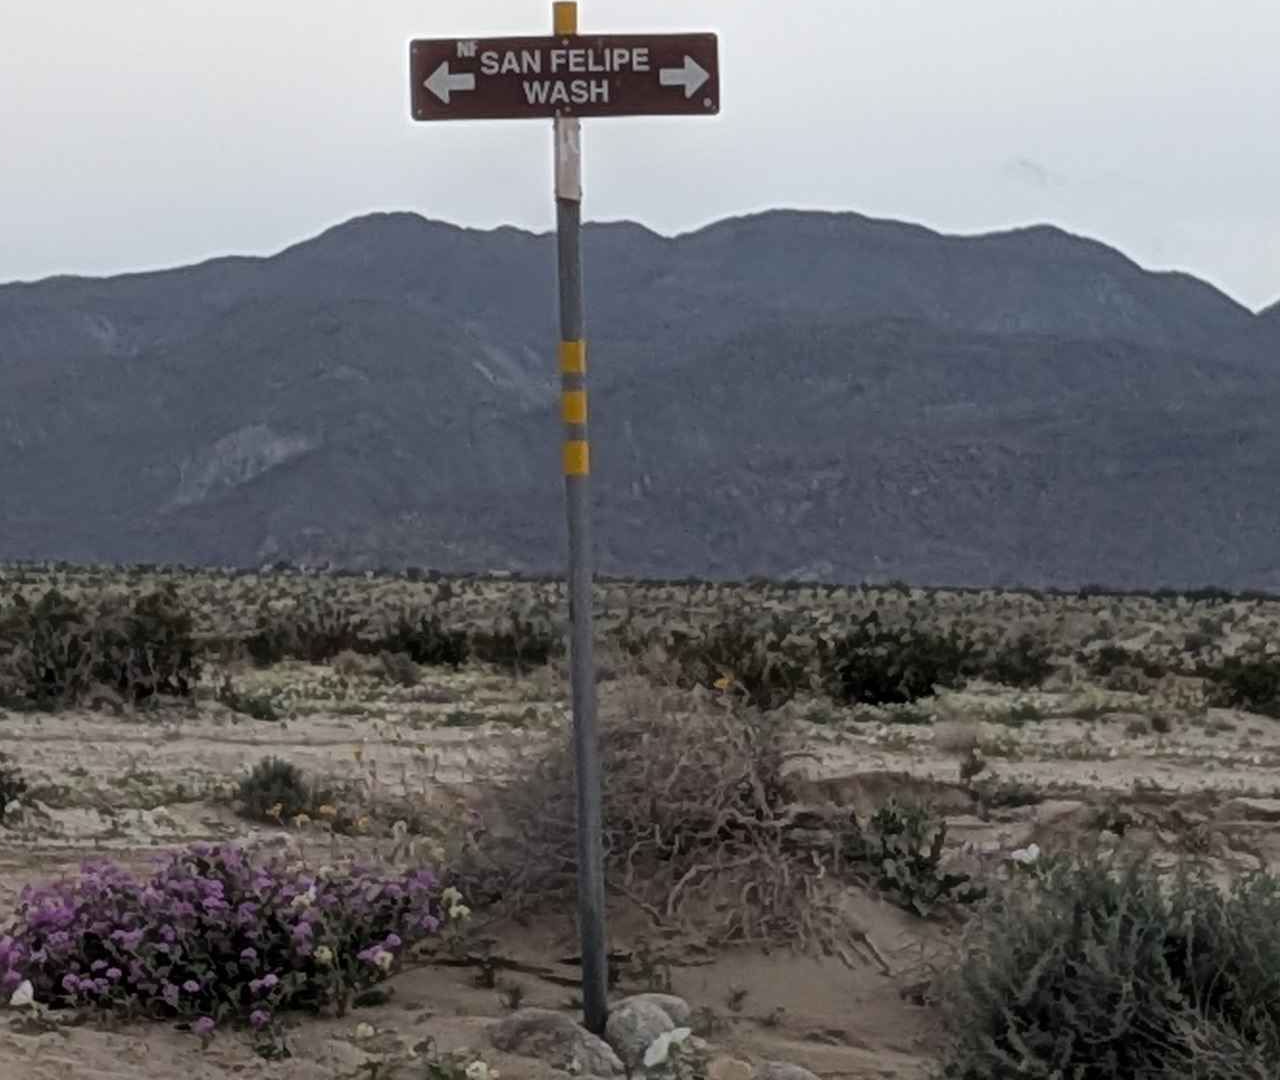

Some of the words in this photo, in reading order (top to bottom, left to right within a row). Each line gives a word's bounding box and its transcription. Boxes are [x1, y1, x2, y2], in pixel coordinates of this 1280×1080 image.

[480, 50, 541, 75] SAN
[550, 47, 650, 72] FELIPE
[523, 80, 609, 104] WASH
